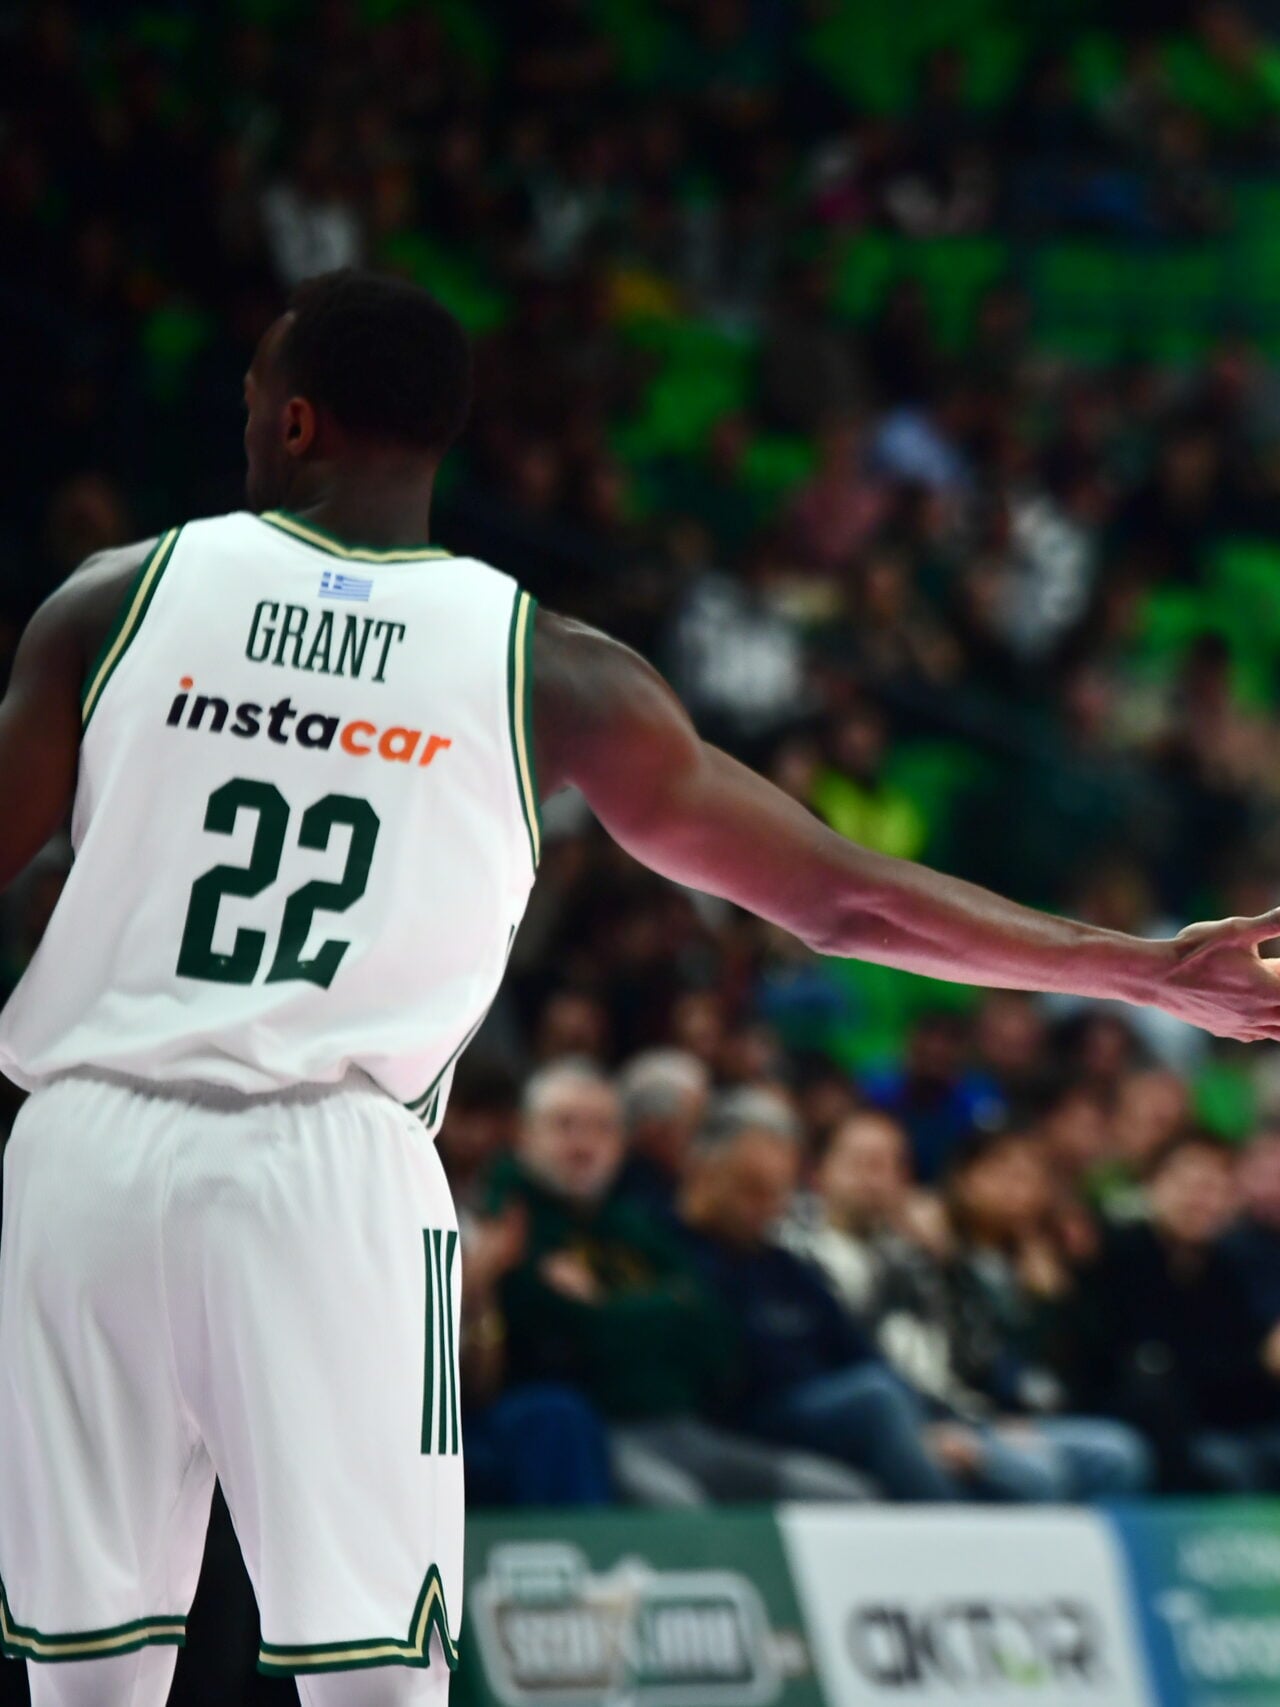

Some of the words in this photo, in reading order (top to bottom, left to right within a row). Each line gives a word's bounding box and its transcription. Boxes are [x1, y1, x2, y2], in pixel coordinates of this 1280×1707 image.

[245, 599, 405, 683] GRANT
[165, 675, 453, 767] instacar
[176, 776, 381, 990] 22
